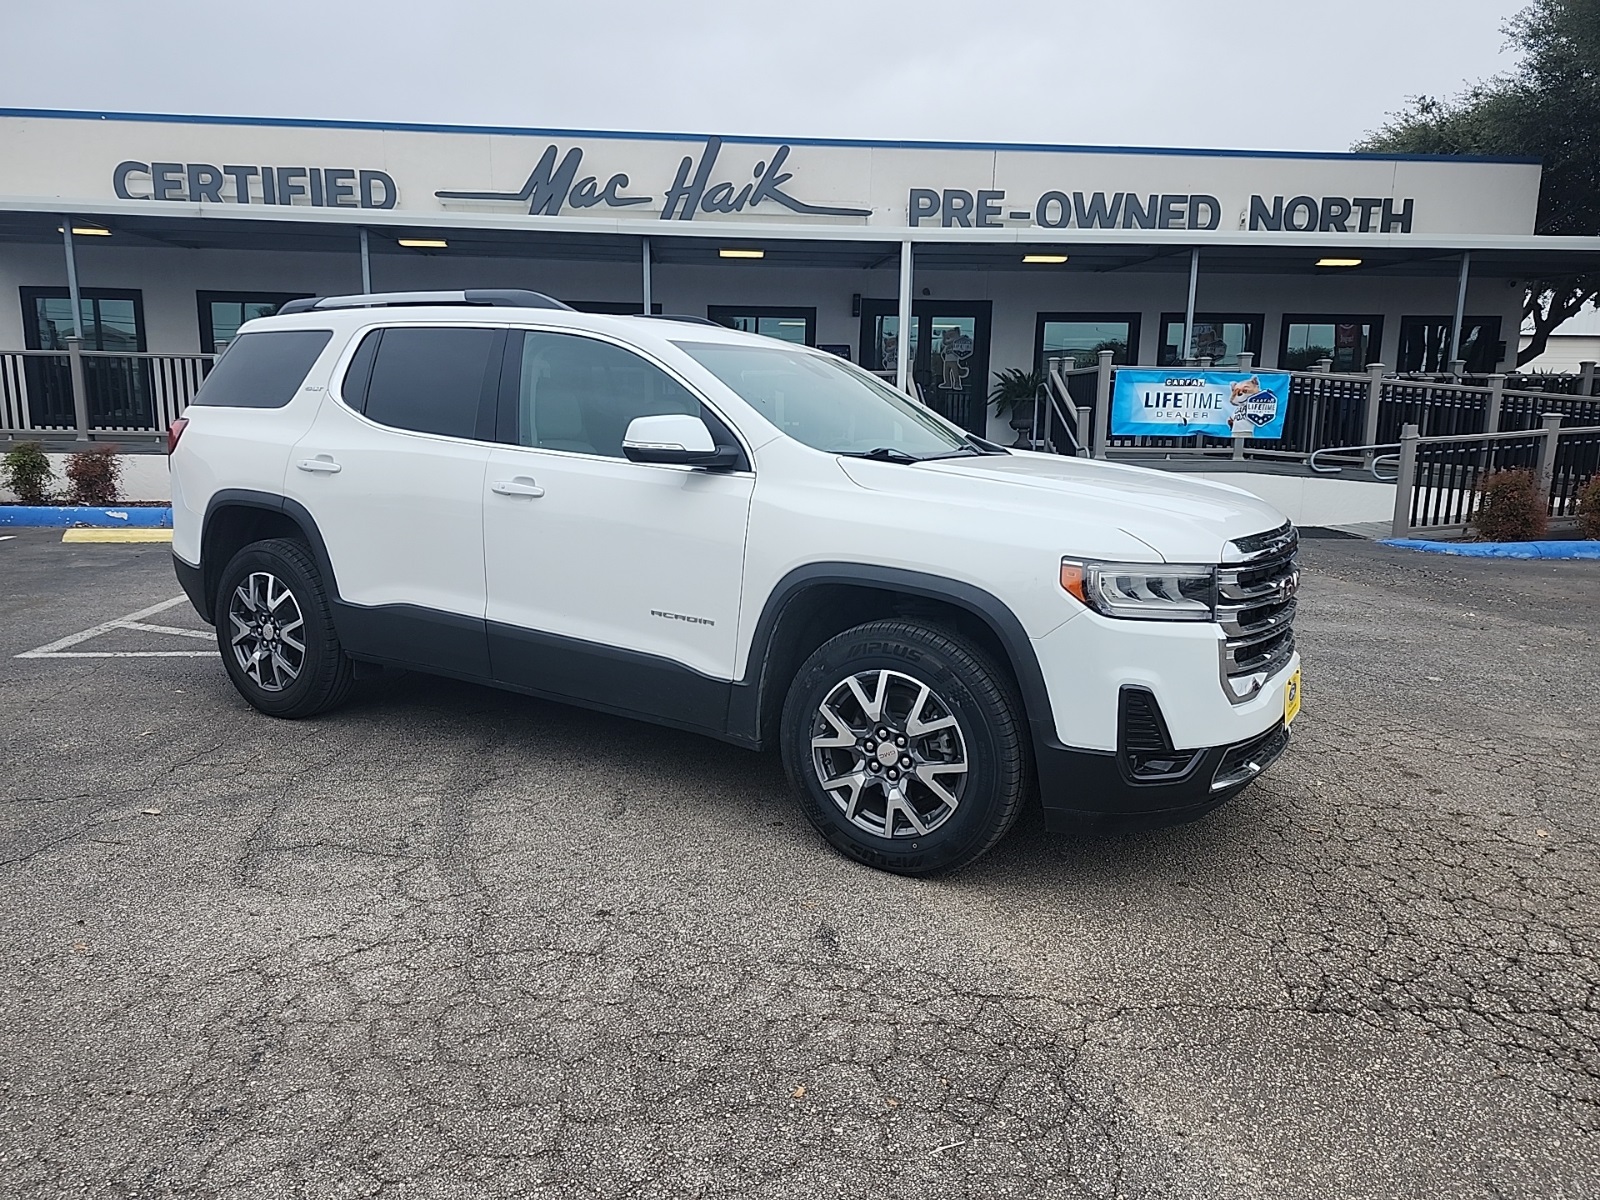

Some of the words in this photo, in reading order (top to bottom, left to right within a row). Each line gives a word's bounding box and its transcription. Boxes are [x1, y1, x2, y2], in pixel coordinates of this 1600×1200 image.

[113, 160, 398, 210] CERTIFIED
[434, 144, 653, 216] Mac
[659, 136, 874, 221] Haik
[908, 188, 1221, 230] PRE-OWNED
[1249, 194, 1415, 232] NORTH
[1165, 378, 1206, 387] CARFAX
[1144, 391, 1224, 410] LIFETIME
[1156, 411, 1209, 419] DEALER
[650, 609, 715, 626] ACADIA
